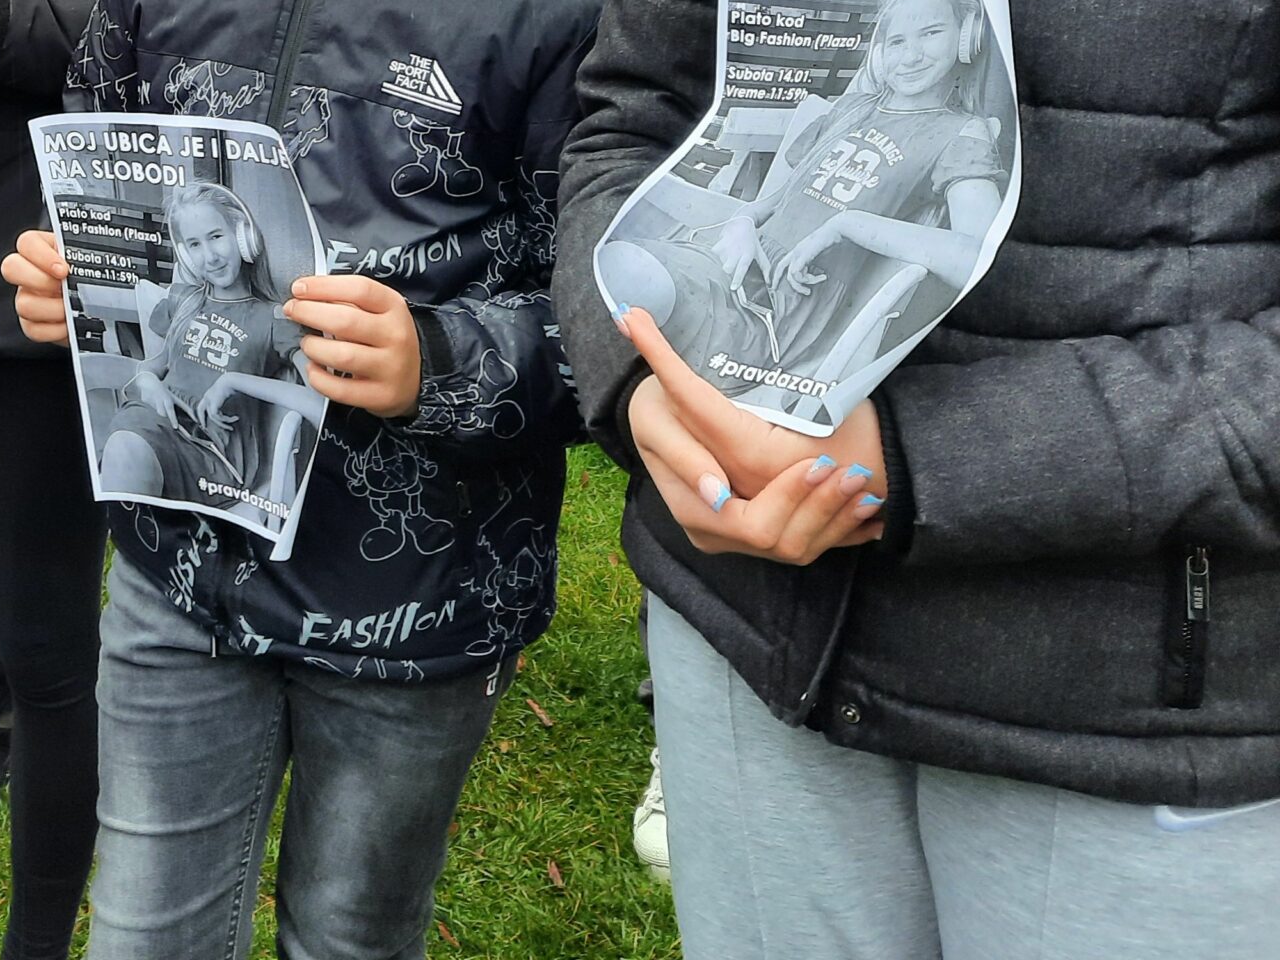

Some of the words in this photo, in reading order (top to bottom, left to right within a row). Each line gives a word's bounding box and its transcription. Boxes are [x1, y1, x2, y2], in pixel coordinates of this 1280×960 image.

[730, 11, 771, 26] Plato
[776, 12, 805, 28] kod
[730, 30, 754, 47] Big
[759, 31, 811, 47] Fashion
[814, 34, 862, 50] (Plaza)
[389, 60, 430, 81] SPORT
[409, 53, 433, 70] THE
[394, 74, 428, 92] FACT
[727, 67, 774, 82] Subota
[777, 69, 813, 83] 14.01.
[725, 85, 765, 99] Vreme
[770, 87, 809, 101] 11:59h
[44, 131, 97, 153] MOJ
[105, 131, 173, 156] UBICA
[179, 136, 205, 159] JE
[211, 136, 219, 159] I
[225, 138, 290, 170] DALJE
[864, 128, 904, 167] CHANGE
[49, 159, 87, 180] NA
[91, 159, 186, 187] SLOBODI
[59, 207, 88, 221] Plato
[90, 209, 111, 221] kod
[61, 221, 80, 236] Big
[82, 224, 122, 238] Fashion
[124, 226, 162, 246] (Plaza)
[66, 248, 102, 265] Subota
[104, 254, 136, 269] 14.01.
[68, 265, 102, 280] Vreme
[104, 268, 140, 285] 11:59h
[210, 313, 248, 342] CHANGE
[708, 352, 838, 398] #pravdazan
[298, 600, 456, 649] FASHION
